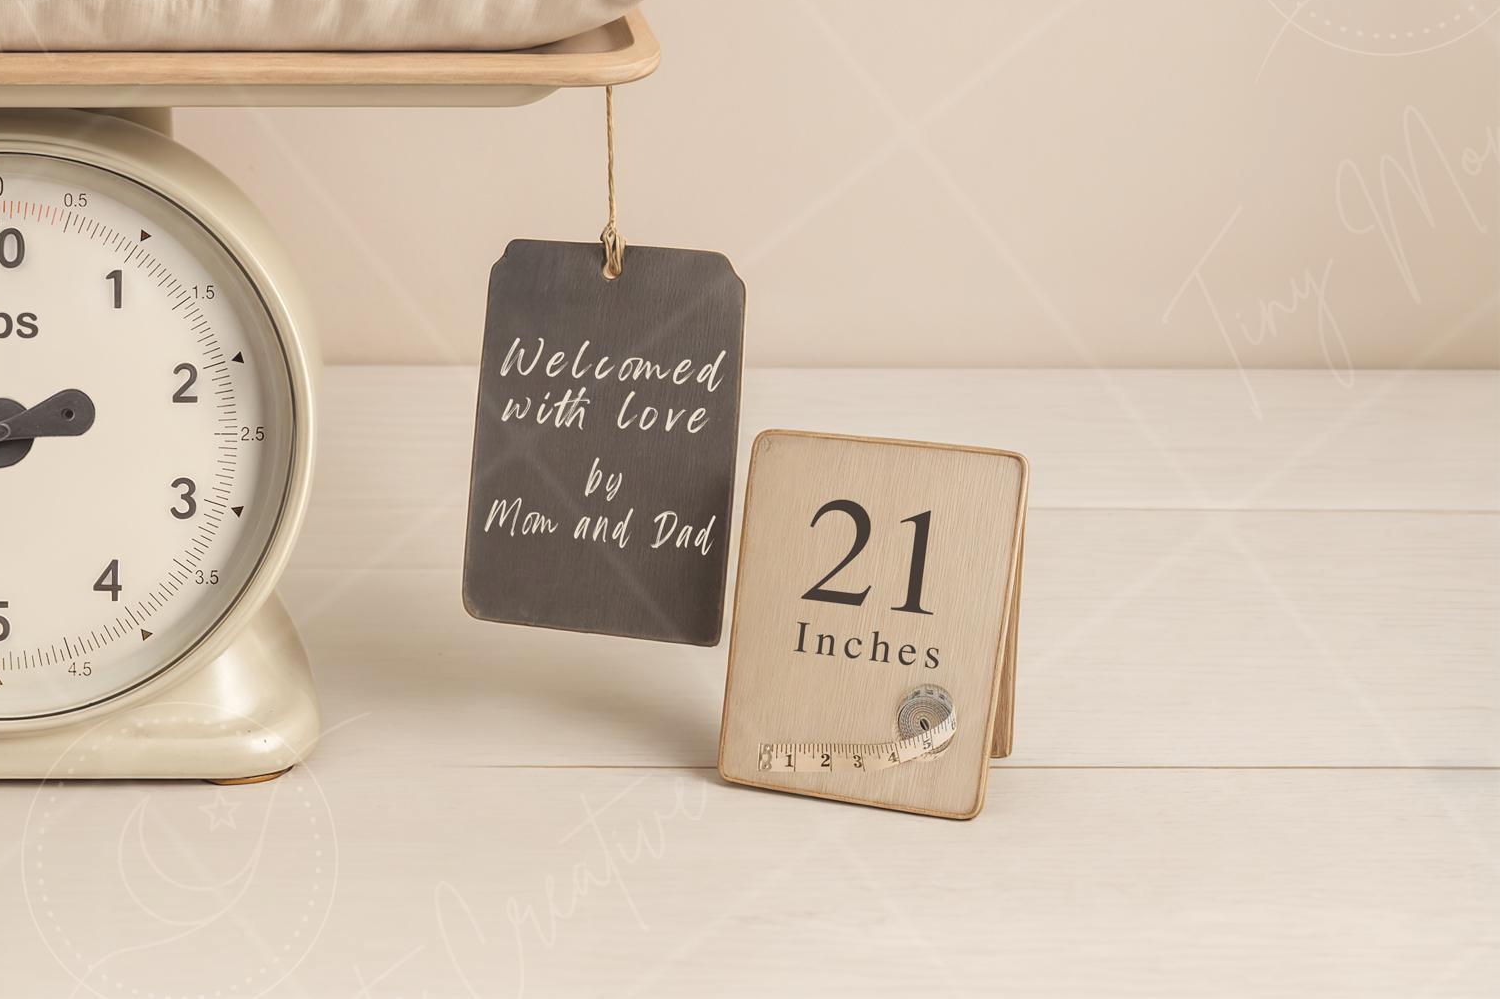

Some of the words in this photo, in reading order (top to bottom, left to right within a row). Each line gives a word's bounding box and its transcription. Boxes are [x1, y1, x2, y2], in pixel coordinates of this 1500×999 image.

[64, 193, 87, 208] 0.5
[105, 270, 123, 309] 1
[193, 285, 215, 300] 1.5
[172, 363, 198, 403] 2
[500, 337, 727, 394] Welcomed
[501, 387, 591, 431] with
[241, 427, 265, 442] 2.5
[170, 478, 197, 519] 3
[584, 457, 623, 502] by
[484, 498, 559, 537] Mom
[574, 509, 633, 548] and
[651, 510, 717, 556] Dad
[196, 570, 219, 585] 3.5
[801, 499, 934, 616] 21
[93, 560, 122, 601] 4
[794, 621, 940, 669] Inches
[68, 662, 92, 677] 4.5
[785, 753, 794, 768] 1
[820, 753, 831, 768] 2
[852, 754, 863, 769] 3
